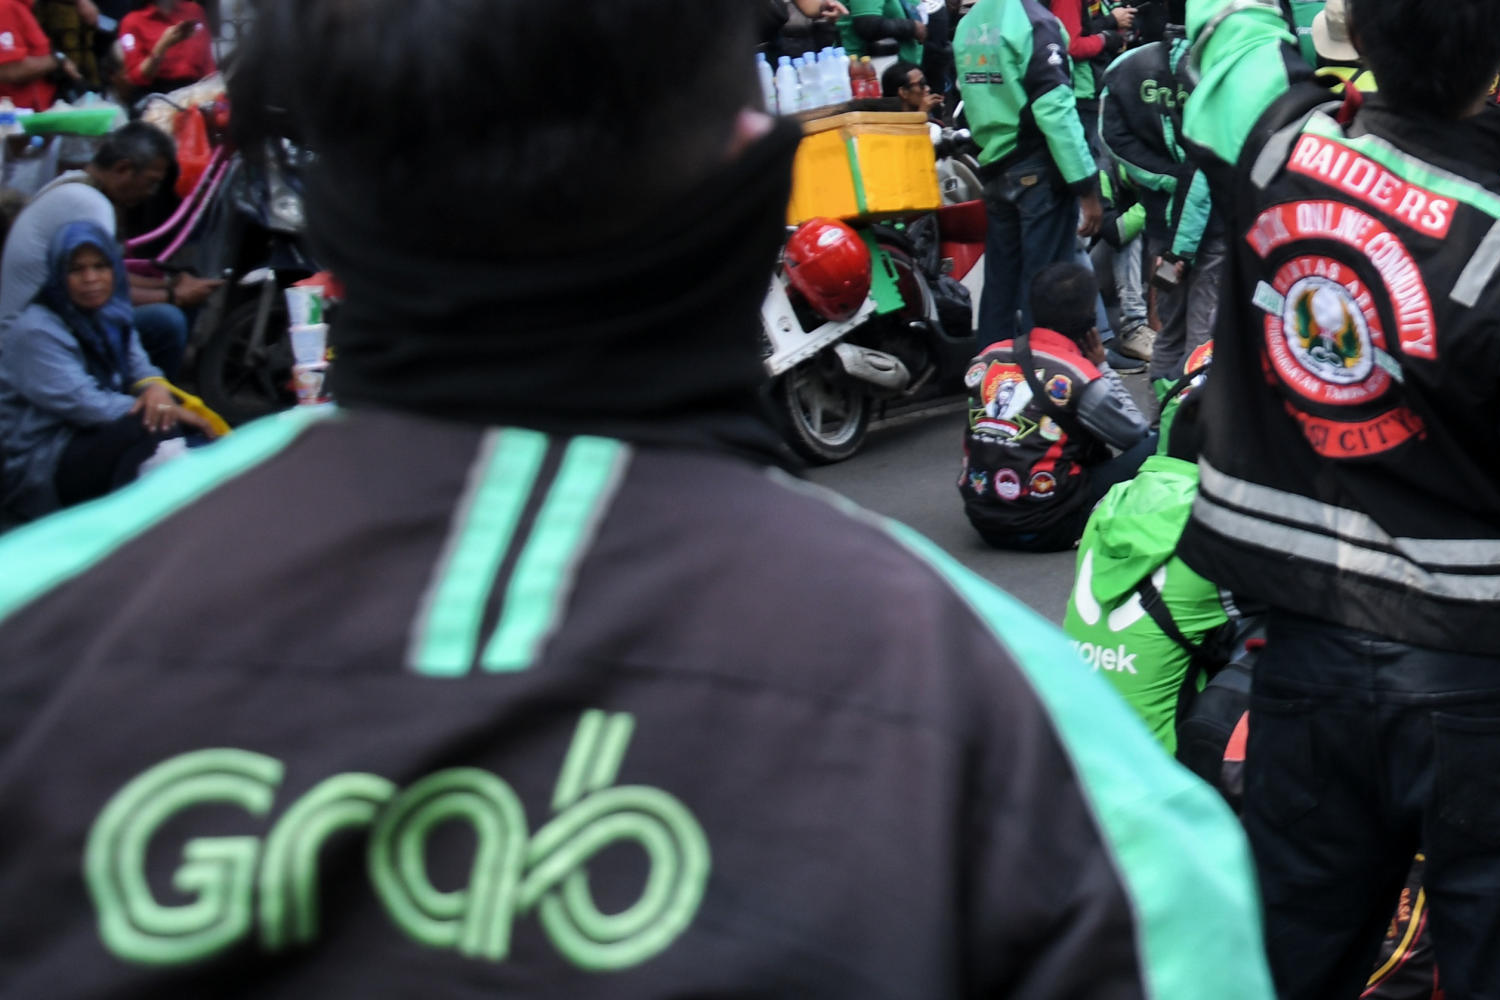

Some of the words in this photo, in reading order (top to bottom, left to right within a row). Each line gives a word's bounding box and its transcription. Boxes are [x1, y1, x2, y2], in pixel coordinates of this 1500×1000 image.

[1292, 136, 1449, 231] RAIDERS
[1296, 202, 1375, 246] ONLINE
[1363, 230, 1434, 354] COMMUNITY
[1345, 279, 1381, 340] AREA
[1068, 640, 1138, 675] ojek
[83, 709, 711, 973] Grab
